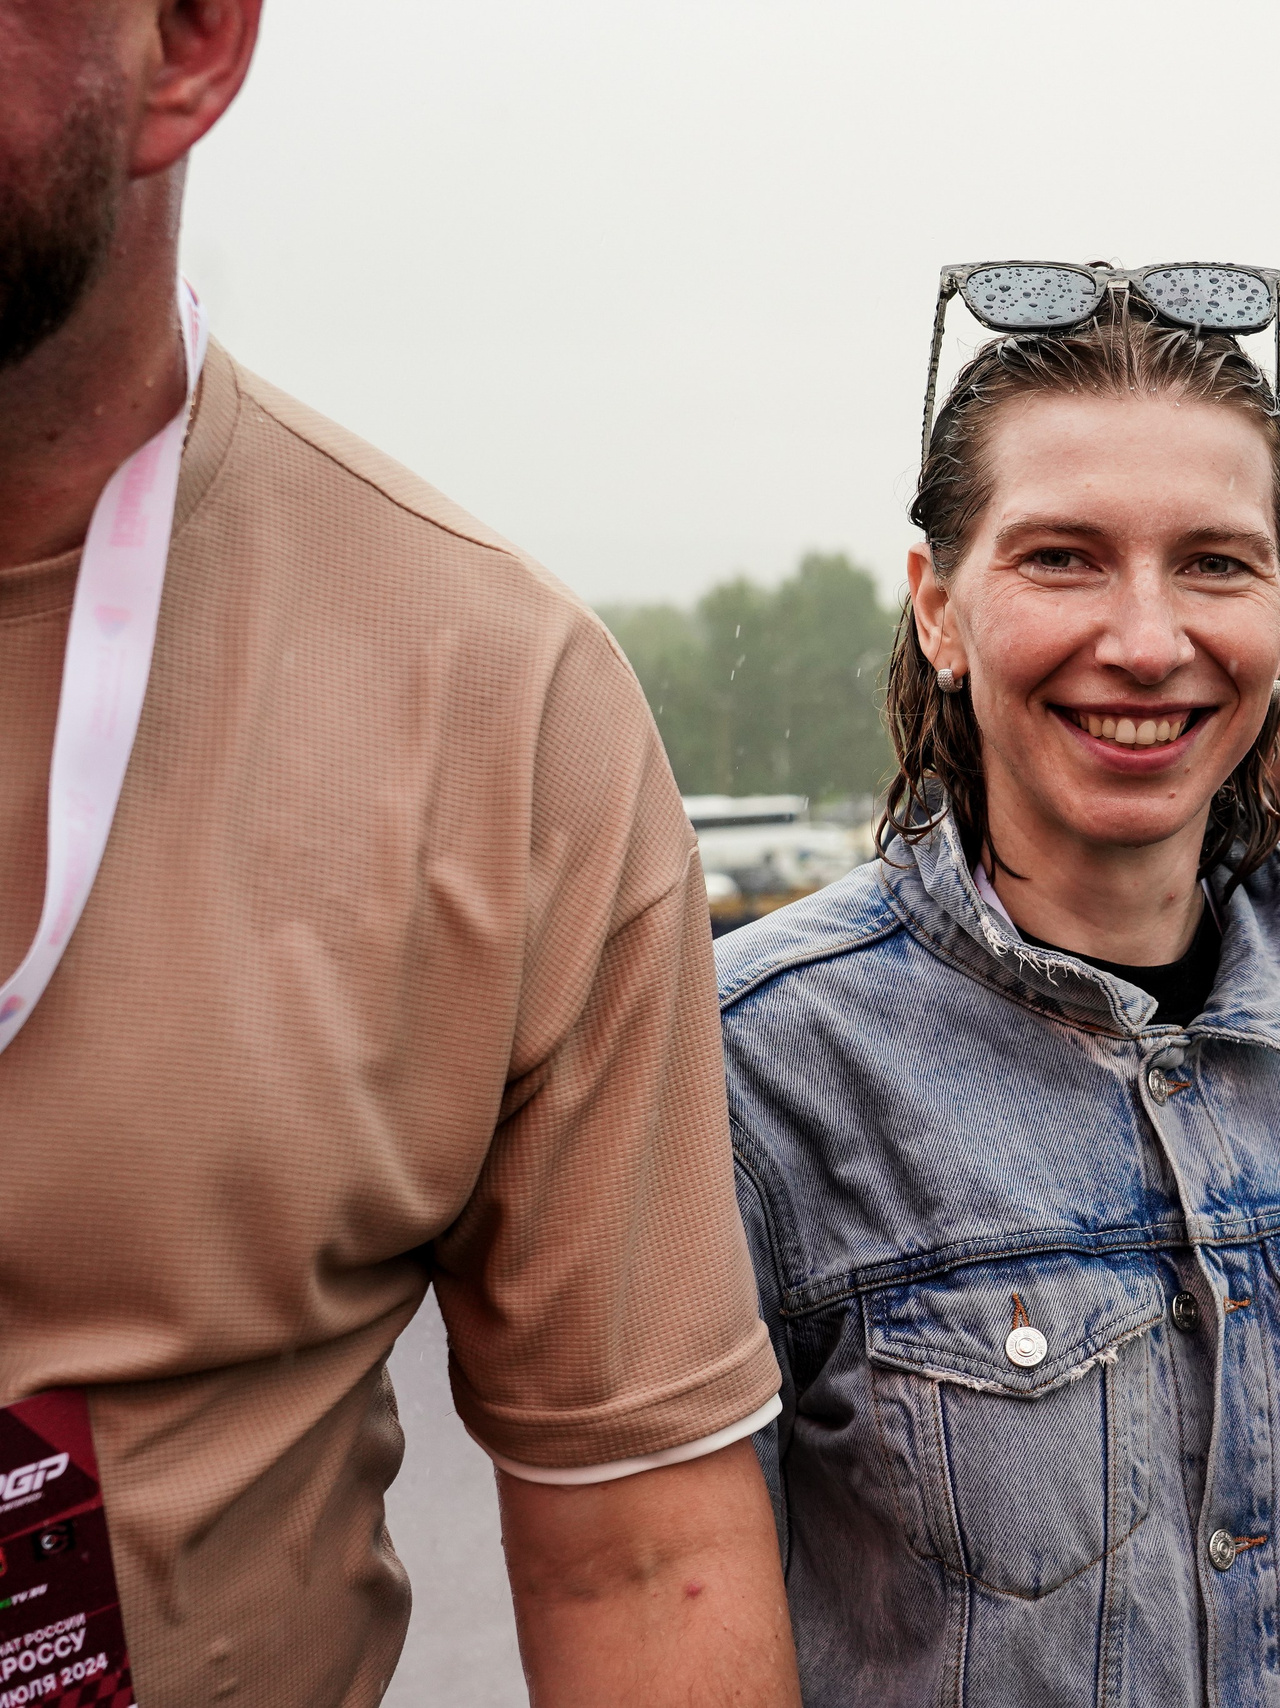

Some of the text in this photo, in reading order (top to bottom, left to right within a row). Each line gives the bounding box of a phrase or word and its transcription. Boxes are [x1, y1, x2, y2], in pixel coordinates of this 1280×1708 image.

[23, 1612, 86, 1648] РОССИИ
[0, 1627, 87, 1684] РОССУ
[60, 1652, 109, 1688] 2024
